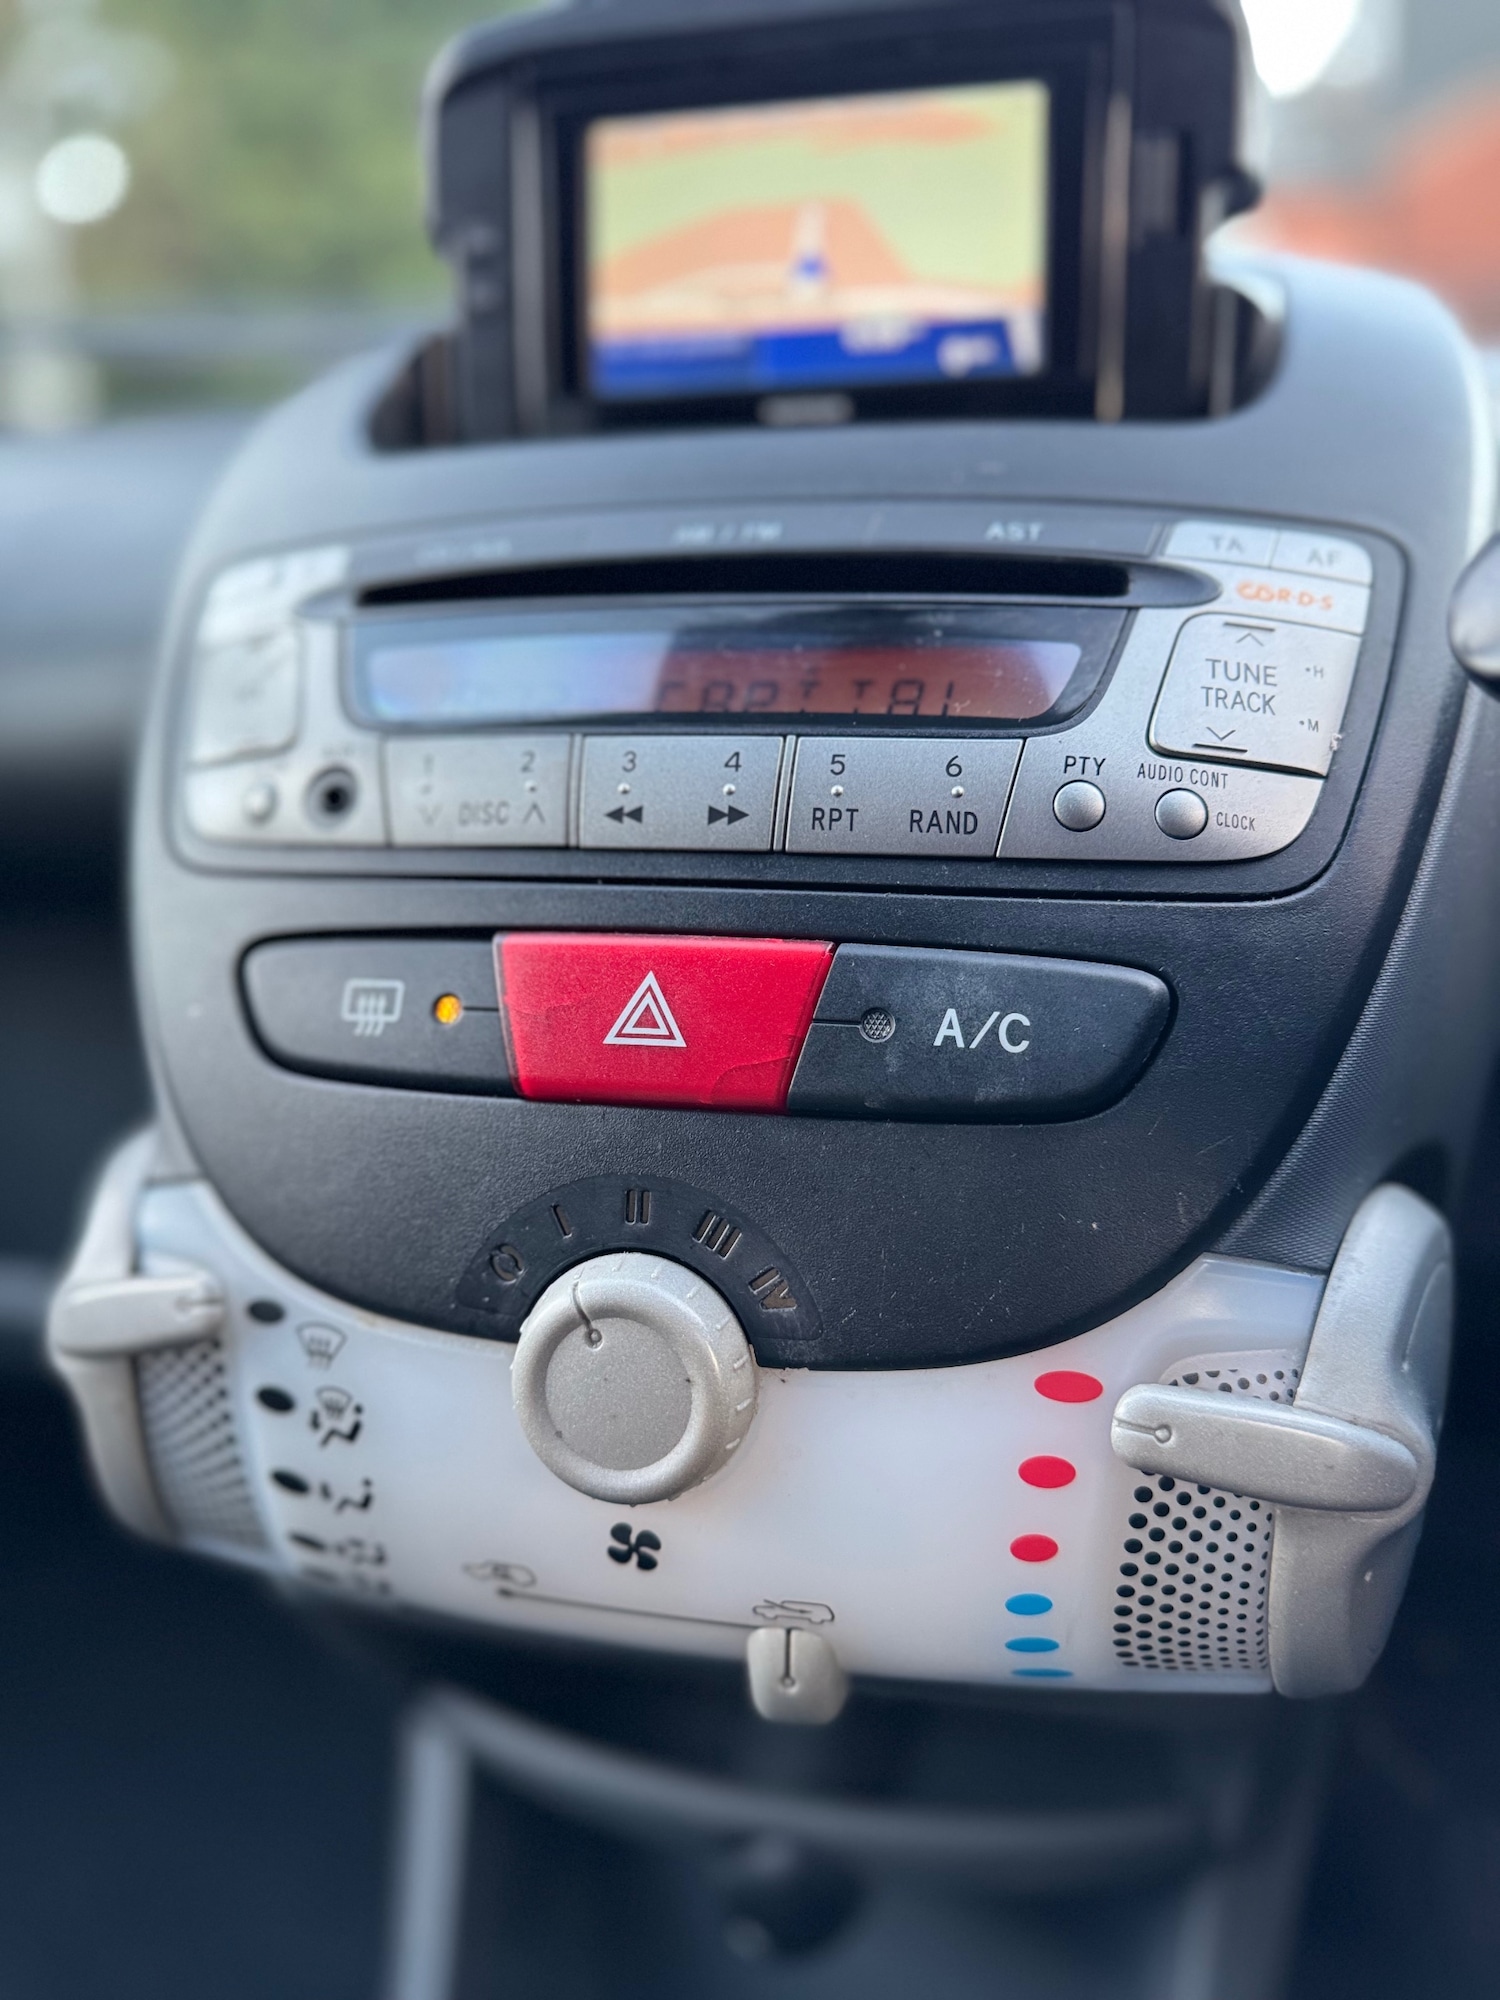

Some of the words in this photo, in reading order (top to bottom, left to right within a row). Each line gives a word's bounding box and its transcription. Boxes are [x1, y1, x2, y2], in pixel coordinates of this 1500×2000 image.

[985, 521, 1044, 541] AST
[1205, 658, 1278, 687] TUNE
[1200, 686, 1276, 716] TRACK
[520, 751, 536, 773] 2
[621, 751, 637, 773] 3
[724, 751, 742, 773] 4
[829, 754, 846, 775] 5
[945, 755, 963, 777] 6
[1063, 755, 1107, 776] PTY
[1137, 762, 1184, 783] AUDIO
[1189, 768, 1229, 789] CONT
[457, 801, 510, 826] DISC
[811, 806, 859, 832] RPT
[909, 809, 978, 835] RAND
[1216, 811, 1256, 832] CLOCK
[932, 1008, 1031, 1053] A/C
